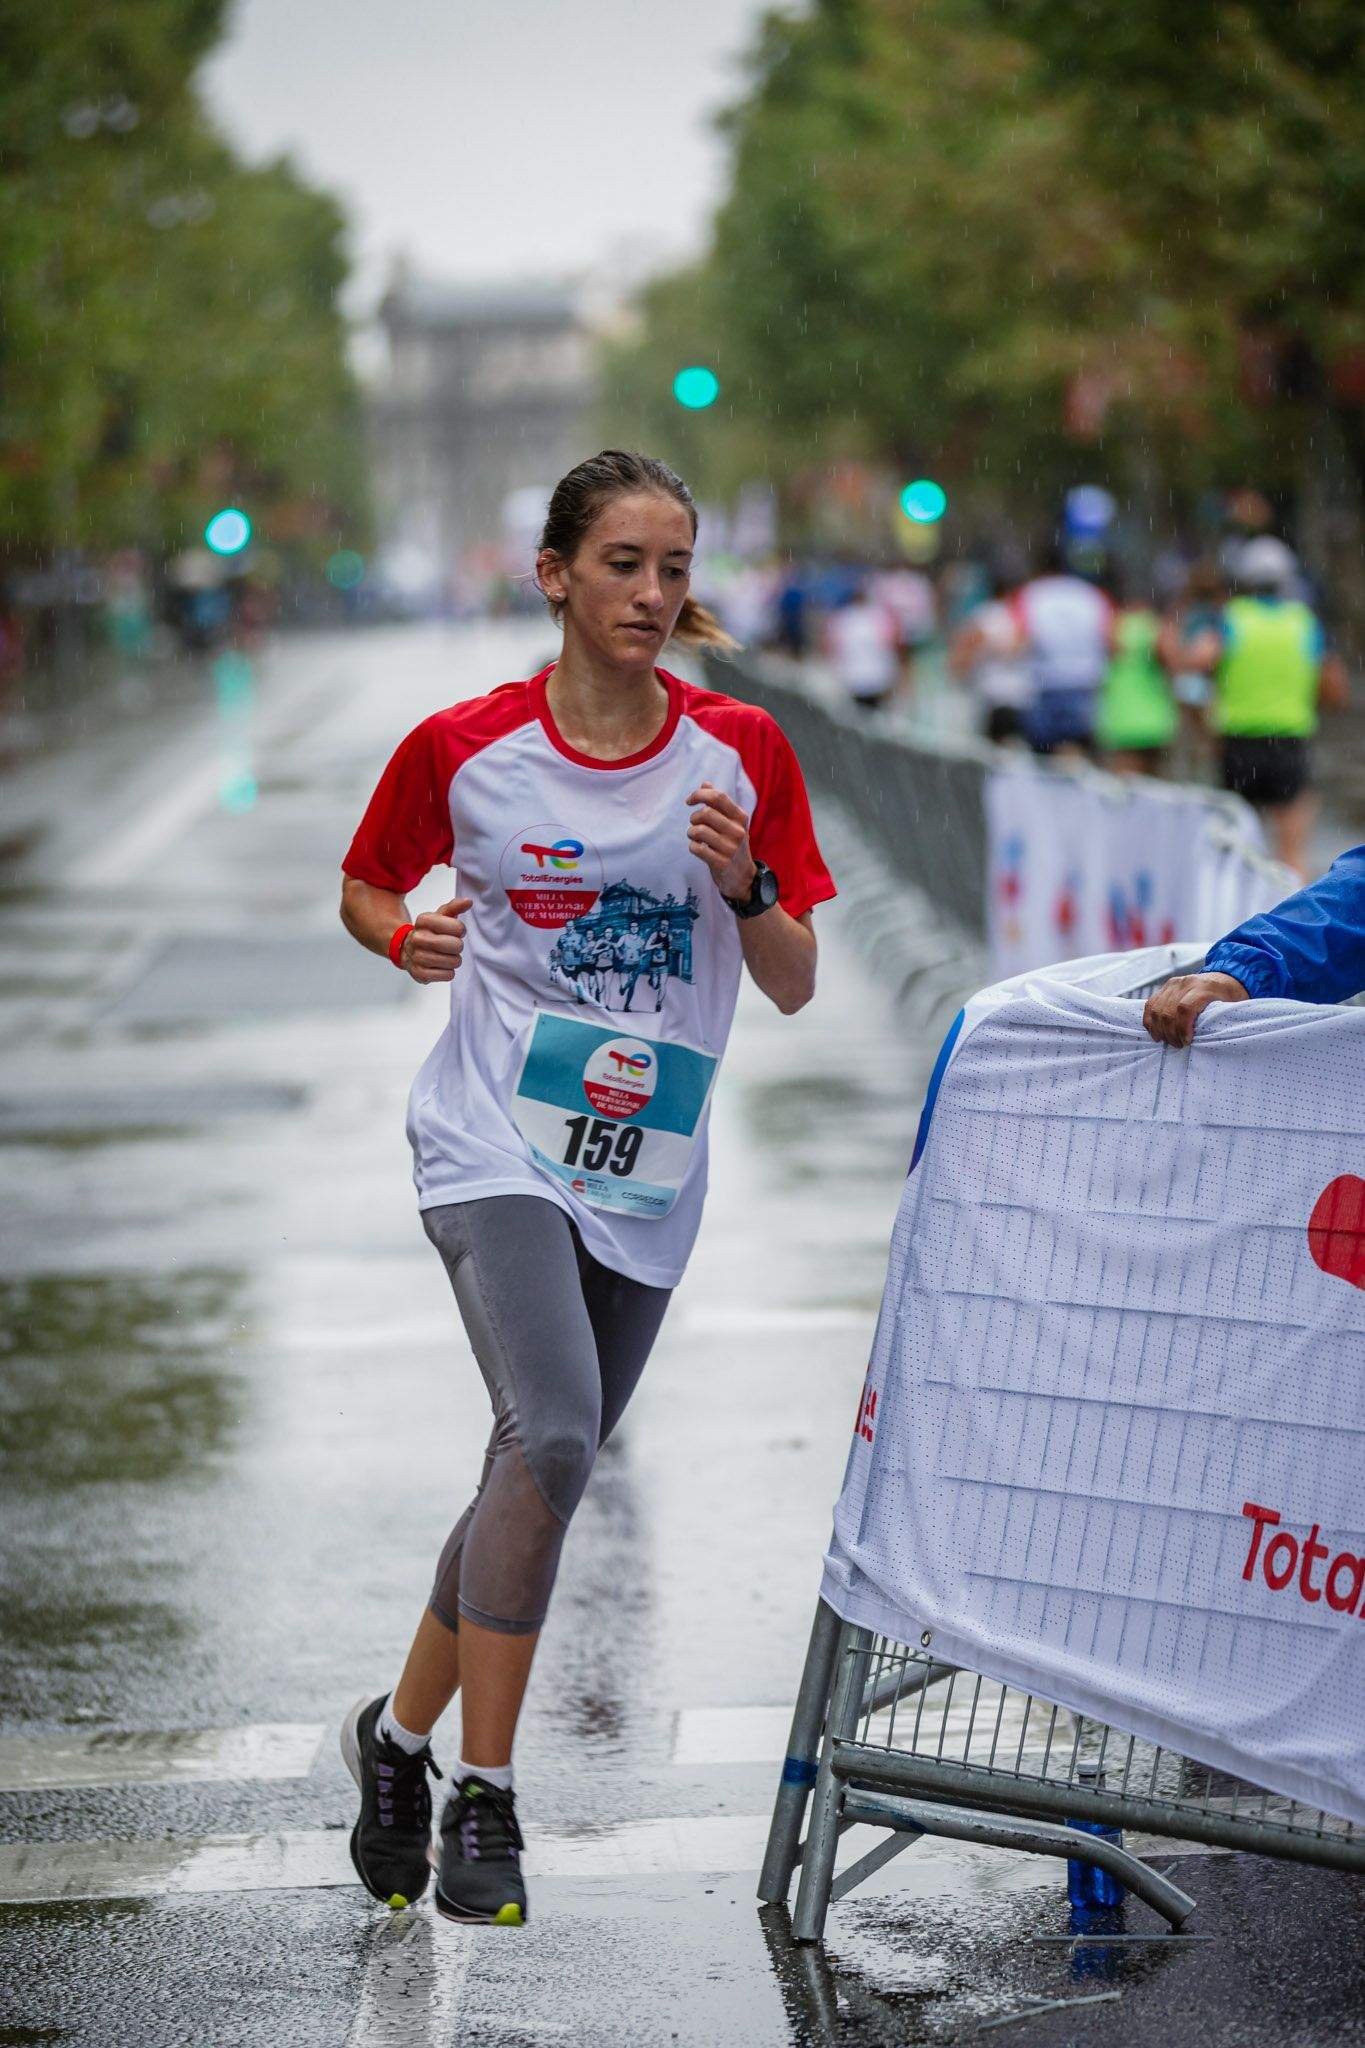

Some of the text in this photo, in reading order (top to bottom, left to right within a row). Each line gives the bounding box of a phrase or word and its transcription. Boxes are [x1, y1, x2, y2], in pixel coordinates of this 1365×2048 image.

[521, 873, 583, 885] TotalEnergies
[563, 1115, 644, 1177] 159
[1242, 1502, 1365, 1619] Tota
